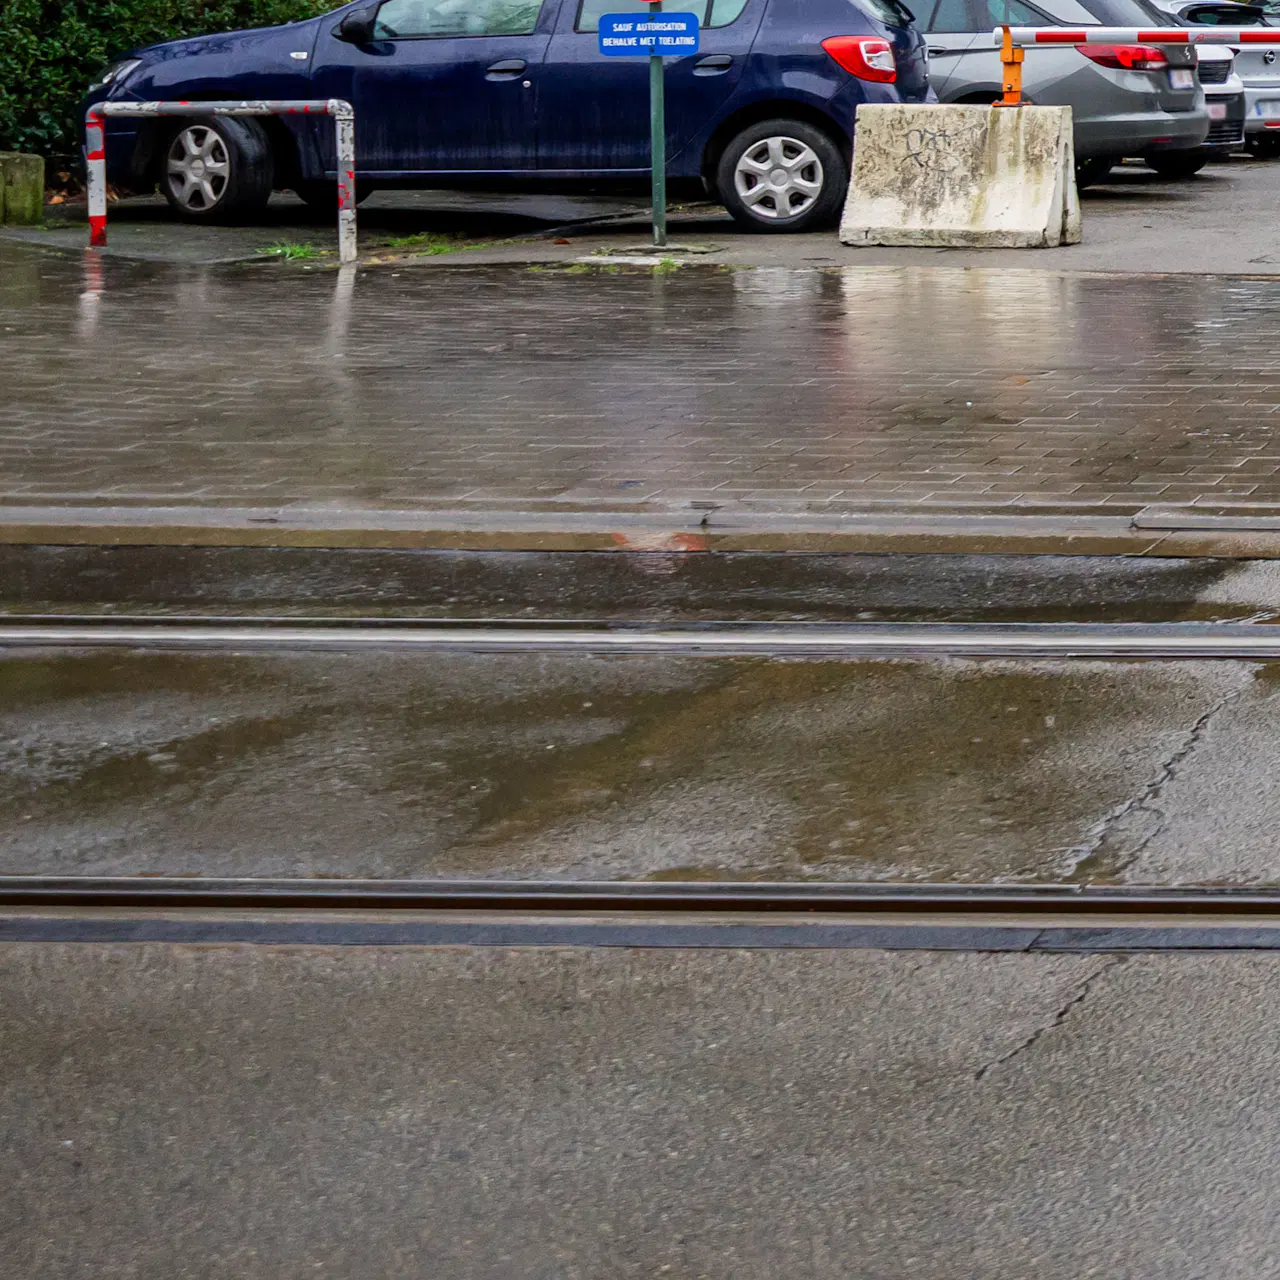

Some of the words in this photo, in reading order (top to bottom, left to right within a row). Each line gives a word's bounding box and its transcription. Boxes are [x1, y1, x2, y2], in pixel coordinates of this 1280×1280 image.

[612, 22, 634, 32] SAUF
[636, 22, 687, 31] AUTORISATION
[602, 37, 638, 46] BEHALVE
[639, 36, 656, 45] MET
[658, 36, 696, 45] TOELATING
